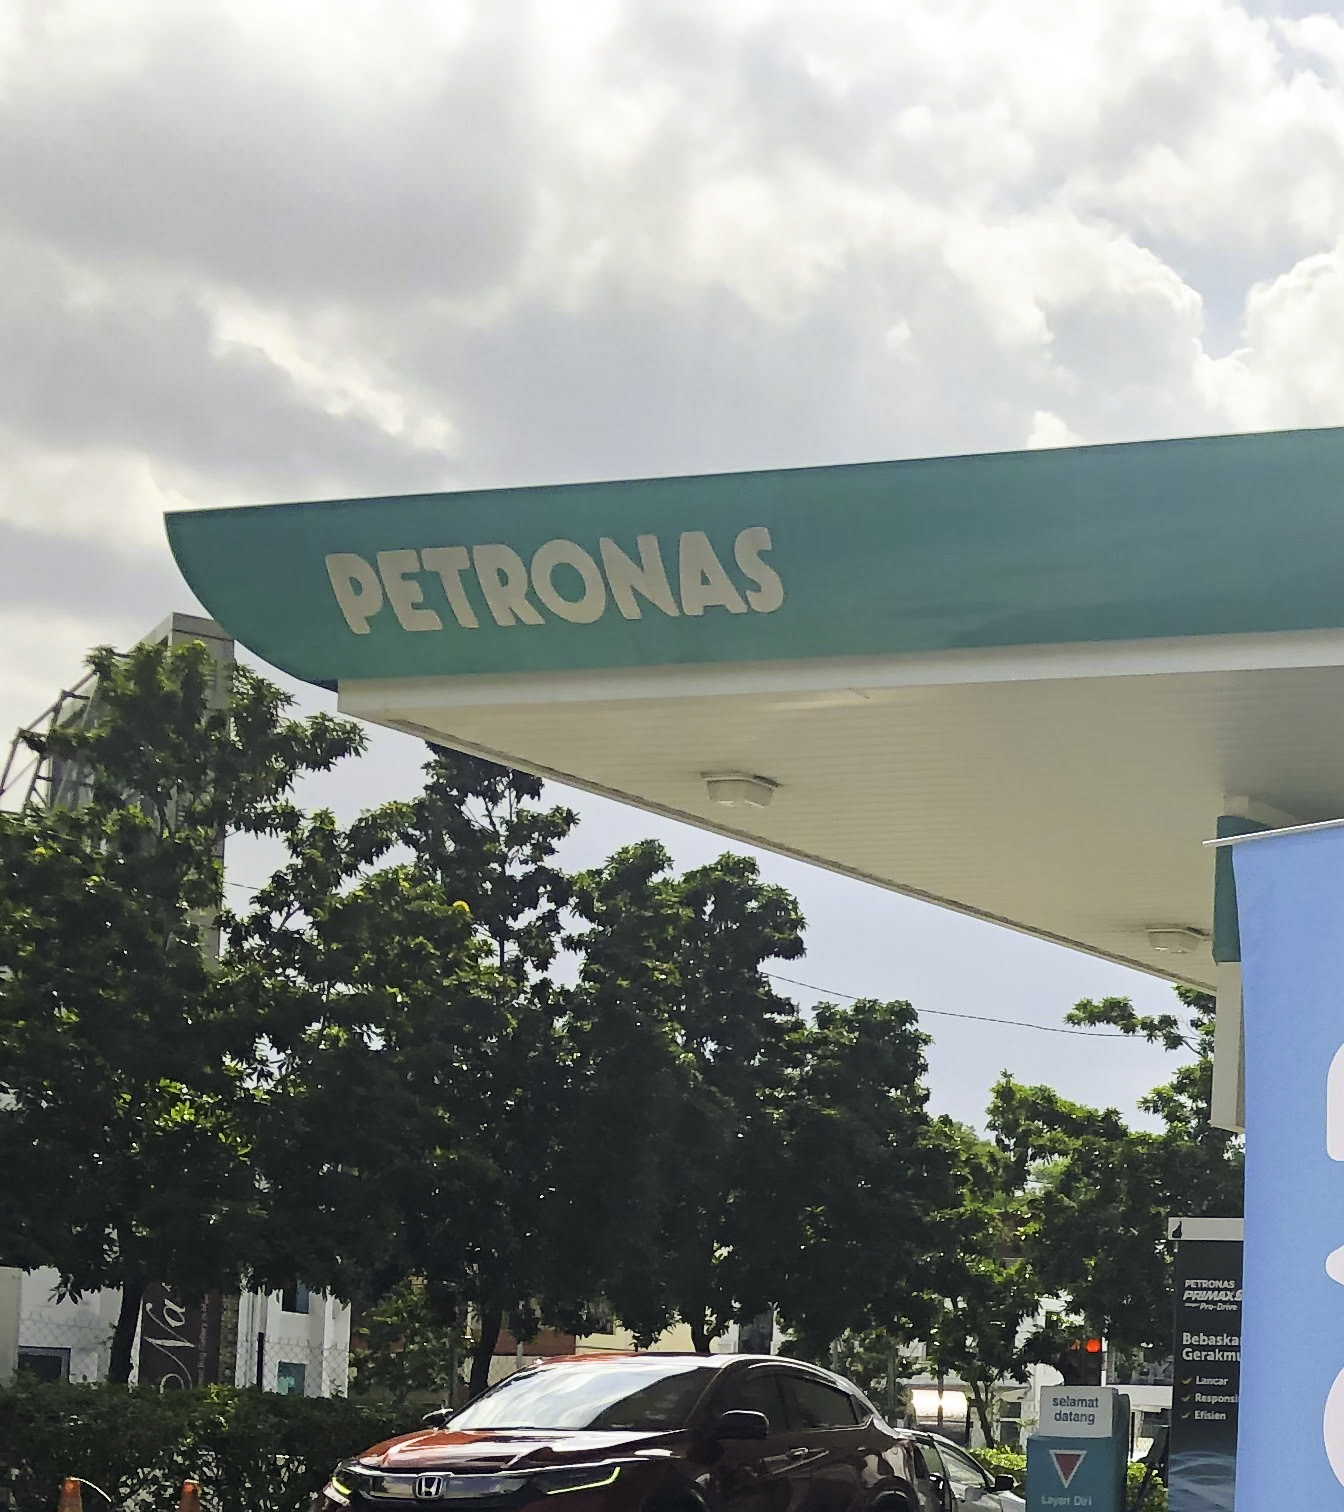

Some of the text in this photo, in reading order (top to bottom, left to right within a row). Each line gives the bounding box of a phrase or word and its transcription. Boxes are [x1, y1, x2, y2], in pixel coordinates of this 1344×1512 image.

[325, 526, 785, 635] PETRONAS
[1184, 1279, 1235, 1289] PETRONAS
[1182, 1332, 1241, 1346] Bebaska
[1195, 1375, 1228, 1386] Lancar
[1052, 1395, 1099, 1408] selamat
[1194, 1392, 1240, 1405] Responsi
[1054, 1410, 1096, 1426] datang
[1194, 1410, 1226, 1420] Efisien
